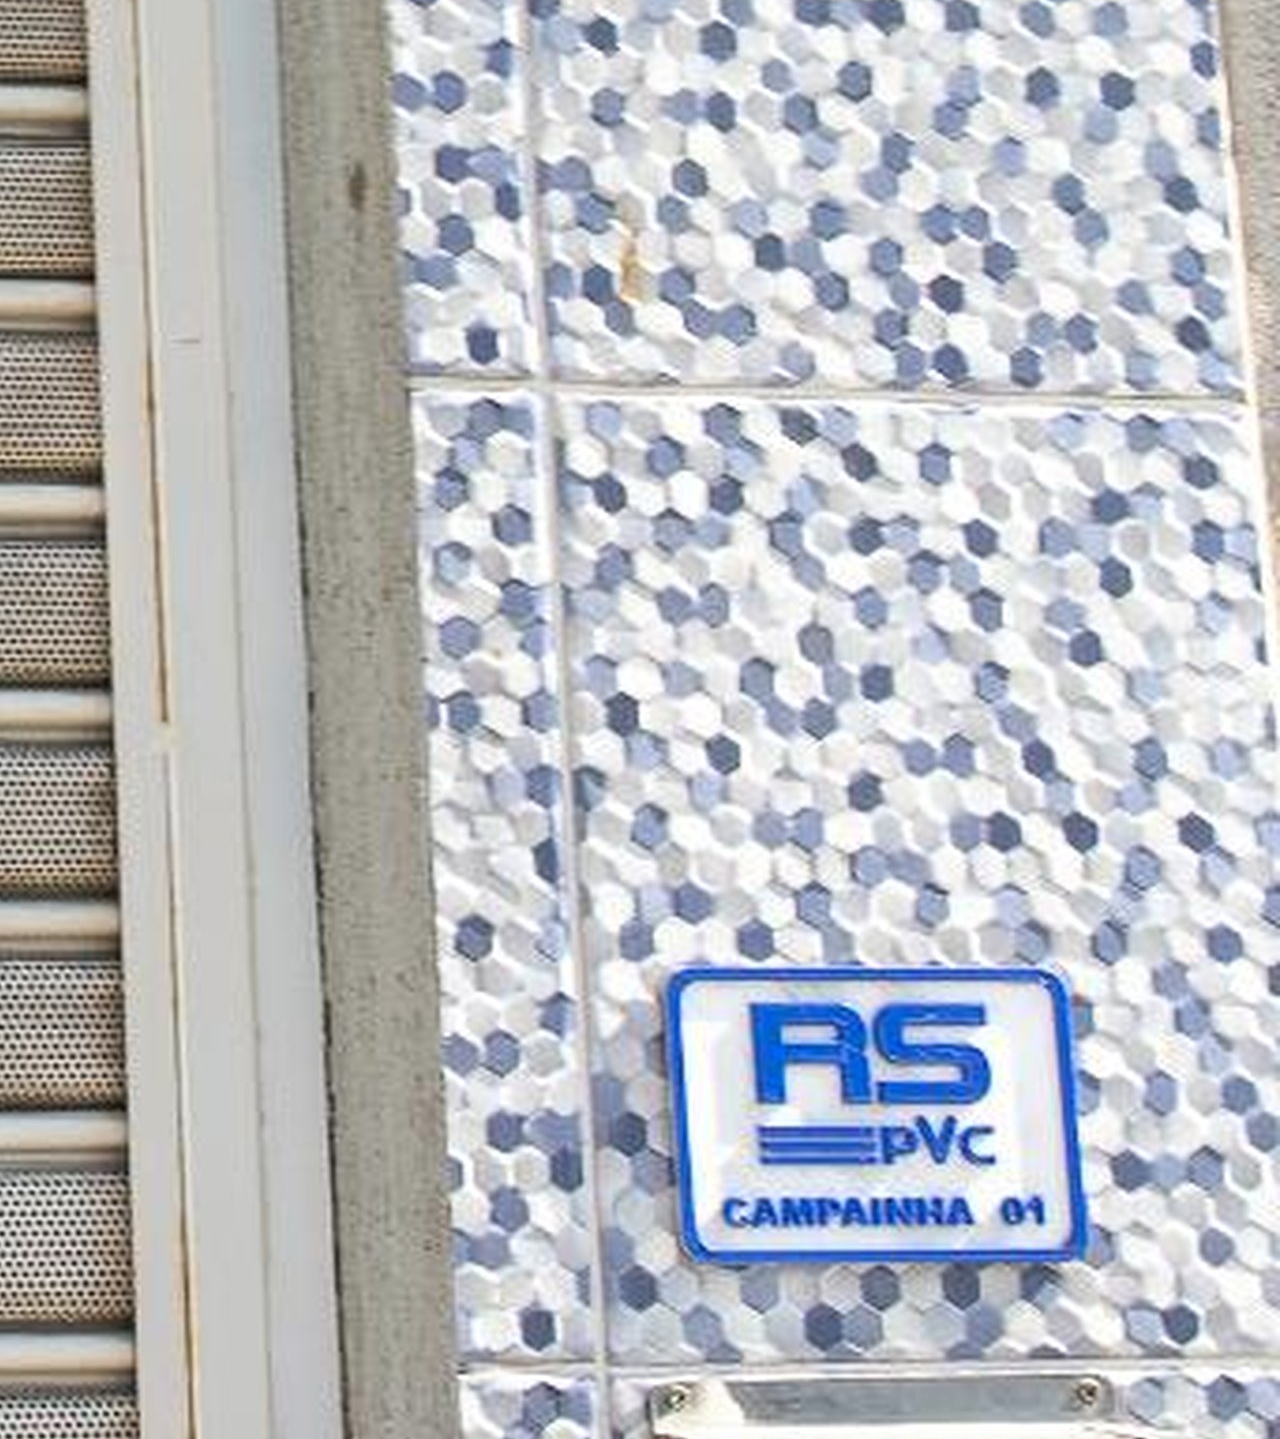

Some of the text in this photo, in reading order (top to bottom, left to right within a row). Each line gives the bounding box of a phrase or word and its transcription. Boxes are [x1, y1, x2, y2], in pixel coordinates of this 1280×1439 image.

[749, 1003, 991, 1104] RS
[722, 1196, 1045, 1228] CAMPAINHA 01
